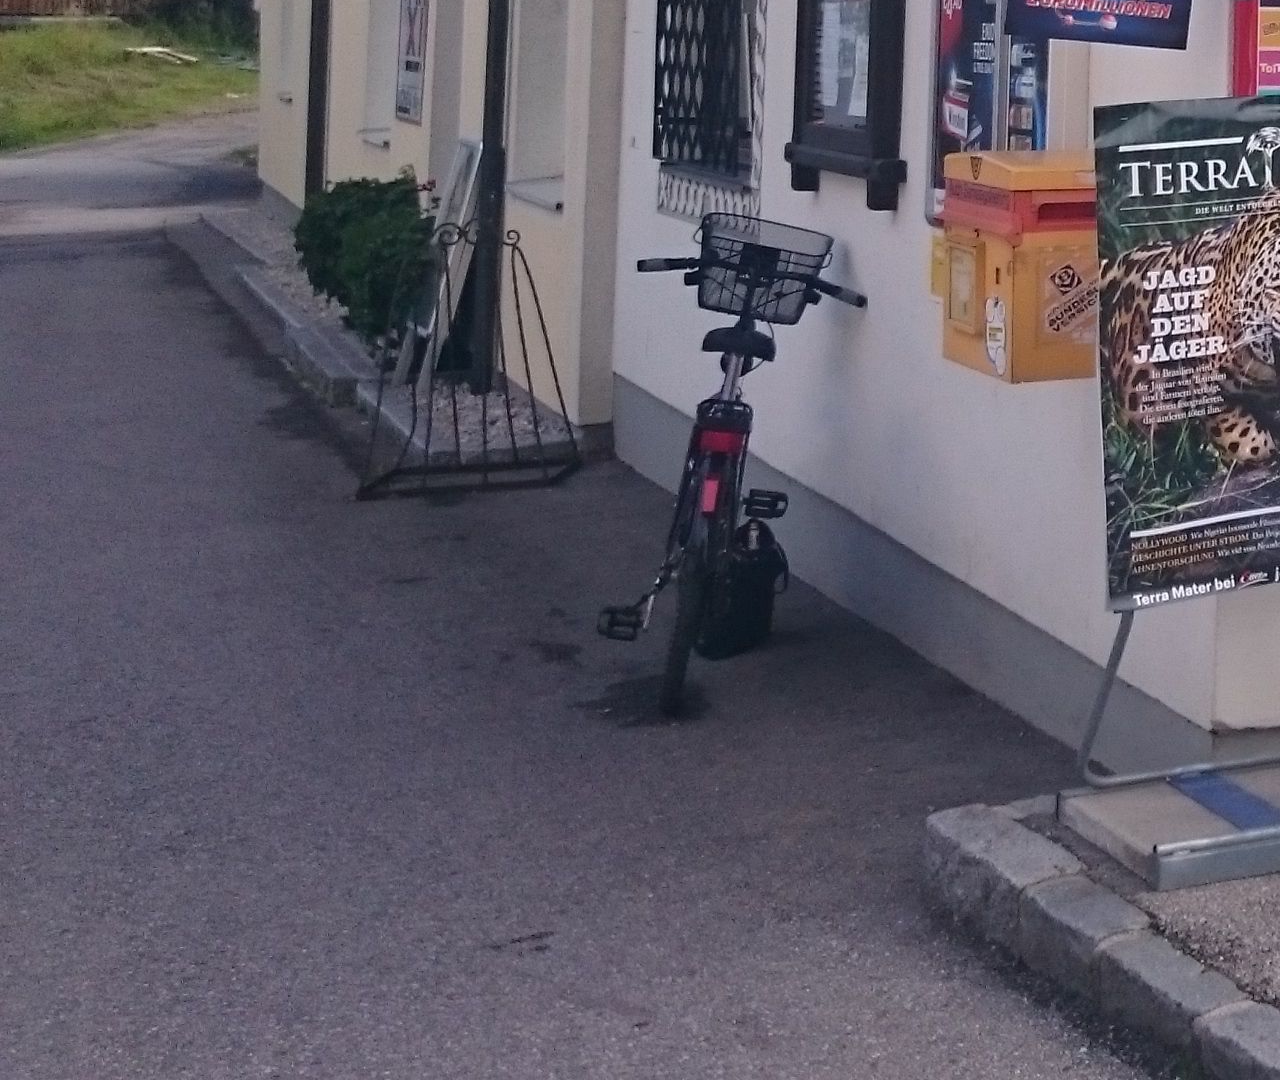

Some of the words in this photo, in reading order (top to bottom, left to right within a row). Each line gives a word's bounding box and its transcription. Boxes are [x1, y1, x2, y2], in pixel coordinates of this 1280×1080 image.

[1118, 155, 1260, 198] TERRA
[1195, 206, 1210, 215] DIE
[1212, 204, 1233, 213] WELT
[1143, 265, 1217, 290] JAGD
[1152, 289, 1210, 313] AUF
[1151, 313, 1211, 337] DEN
[1133, 335, 1228, 364] JÄGER
[1149, 380, 1176, 393] Jaguar
[1131, 534, 1188, 551] NOLLYWOOD
[1131, 544, 1189, 563] GESCHICHTE
[1189, 540, 1218, 552] UNTER
[1219, 533, 1250, 546] STROM
[1133, 591, 1170, 607] Terra
[1171, 582, 1212, 600] Mater
[1214, 574, 1236, 591] bei
